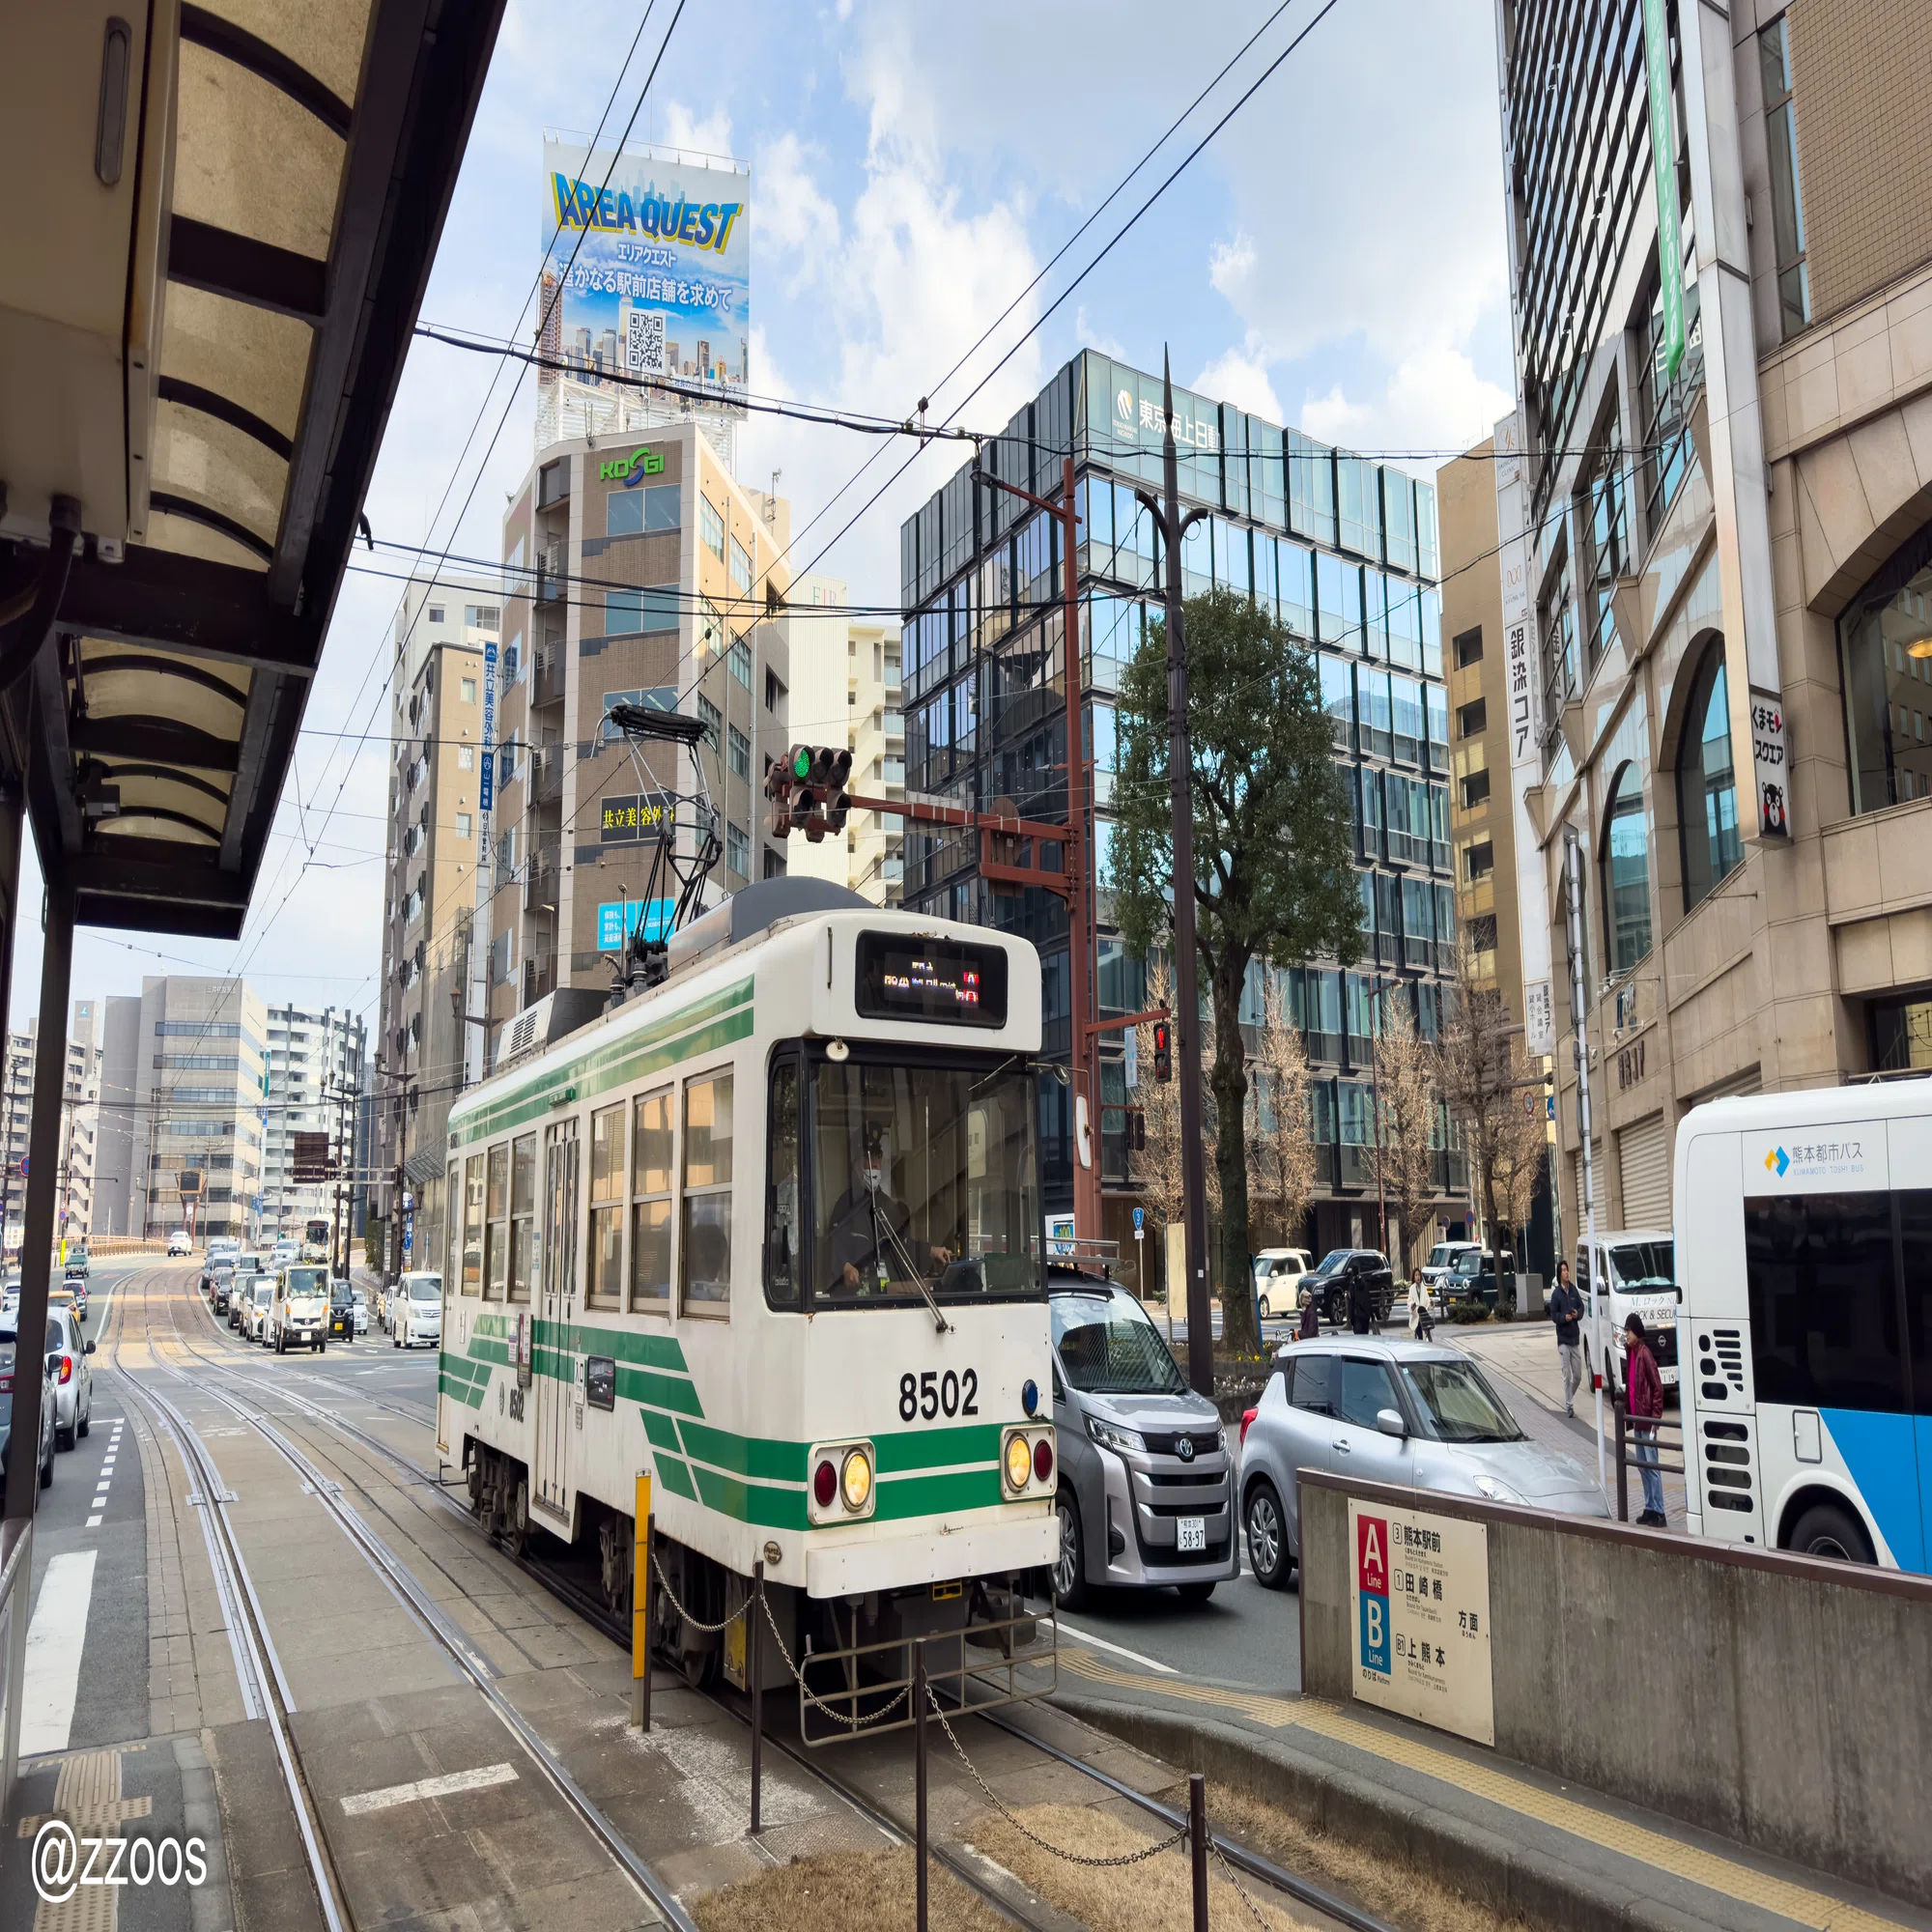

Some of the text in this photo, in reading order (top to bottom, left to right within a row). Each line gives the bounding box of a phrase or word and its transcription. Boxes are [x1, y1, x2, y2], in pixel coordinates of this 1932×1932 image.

[551, 172, 744, 256] AREA QUEST
[617, 243, 676, 269] エリアクエスト
[1139, 399, 1220, 451] 東京海上日動
[600, 446, 666, 487] KOSGI
[484, 662, 496, 751] 共立美容外科
[1510, 626, 1529, 758] 銀染コア
[1754, 739, 1783, 765] スクエア
[1792, 1142, 1863, 1164] 熊本都市バス
[1793, 1164, 1864, 1177] KUMAMOTO TOSHI BUS
[1650, 1310, 1655, 1320] &
[898, 1368, 979, 1422] 8502
[1364, 1523, 1383, 1573] A
[1404, 1524, 1441, 1553] 熊本駅前
[1367, 1573, 1381, 1589] Line
[1406, 1573, 1442, 1602] 田崎橋
[1368, 1599, 1383, 1648] B
[1459, 1610, 1478, 1633] 方面
[1368, 1649, 1383, 1666] Line
[1397, 1639, 1405, 1652] B1
[1407, 1637, 1445, 1668] 上熊本
[1362, 1668, 1378, 1682] のりば
